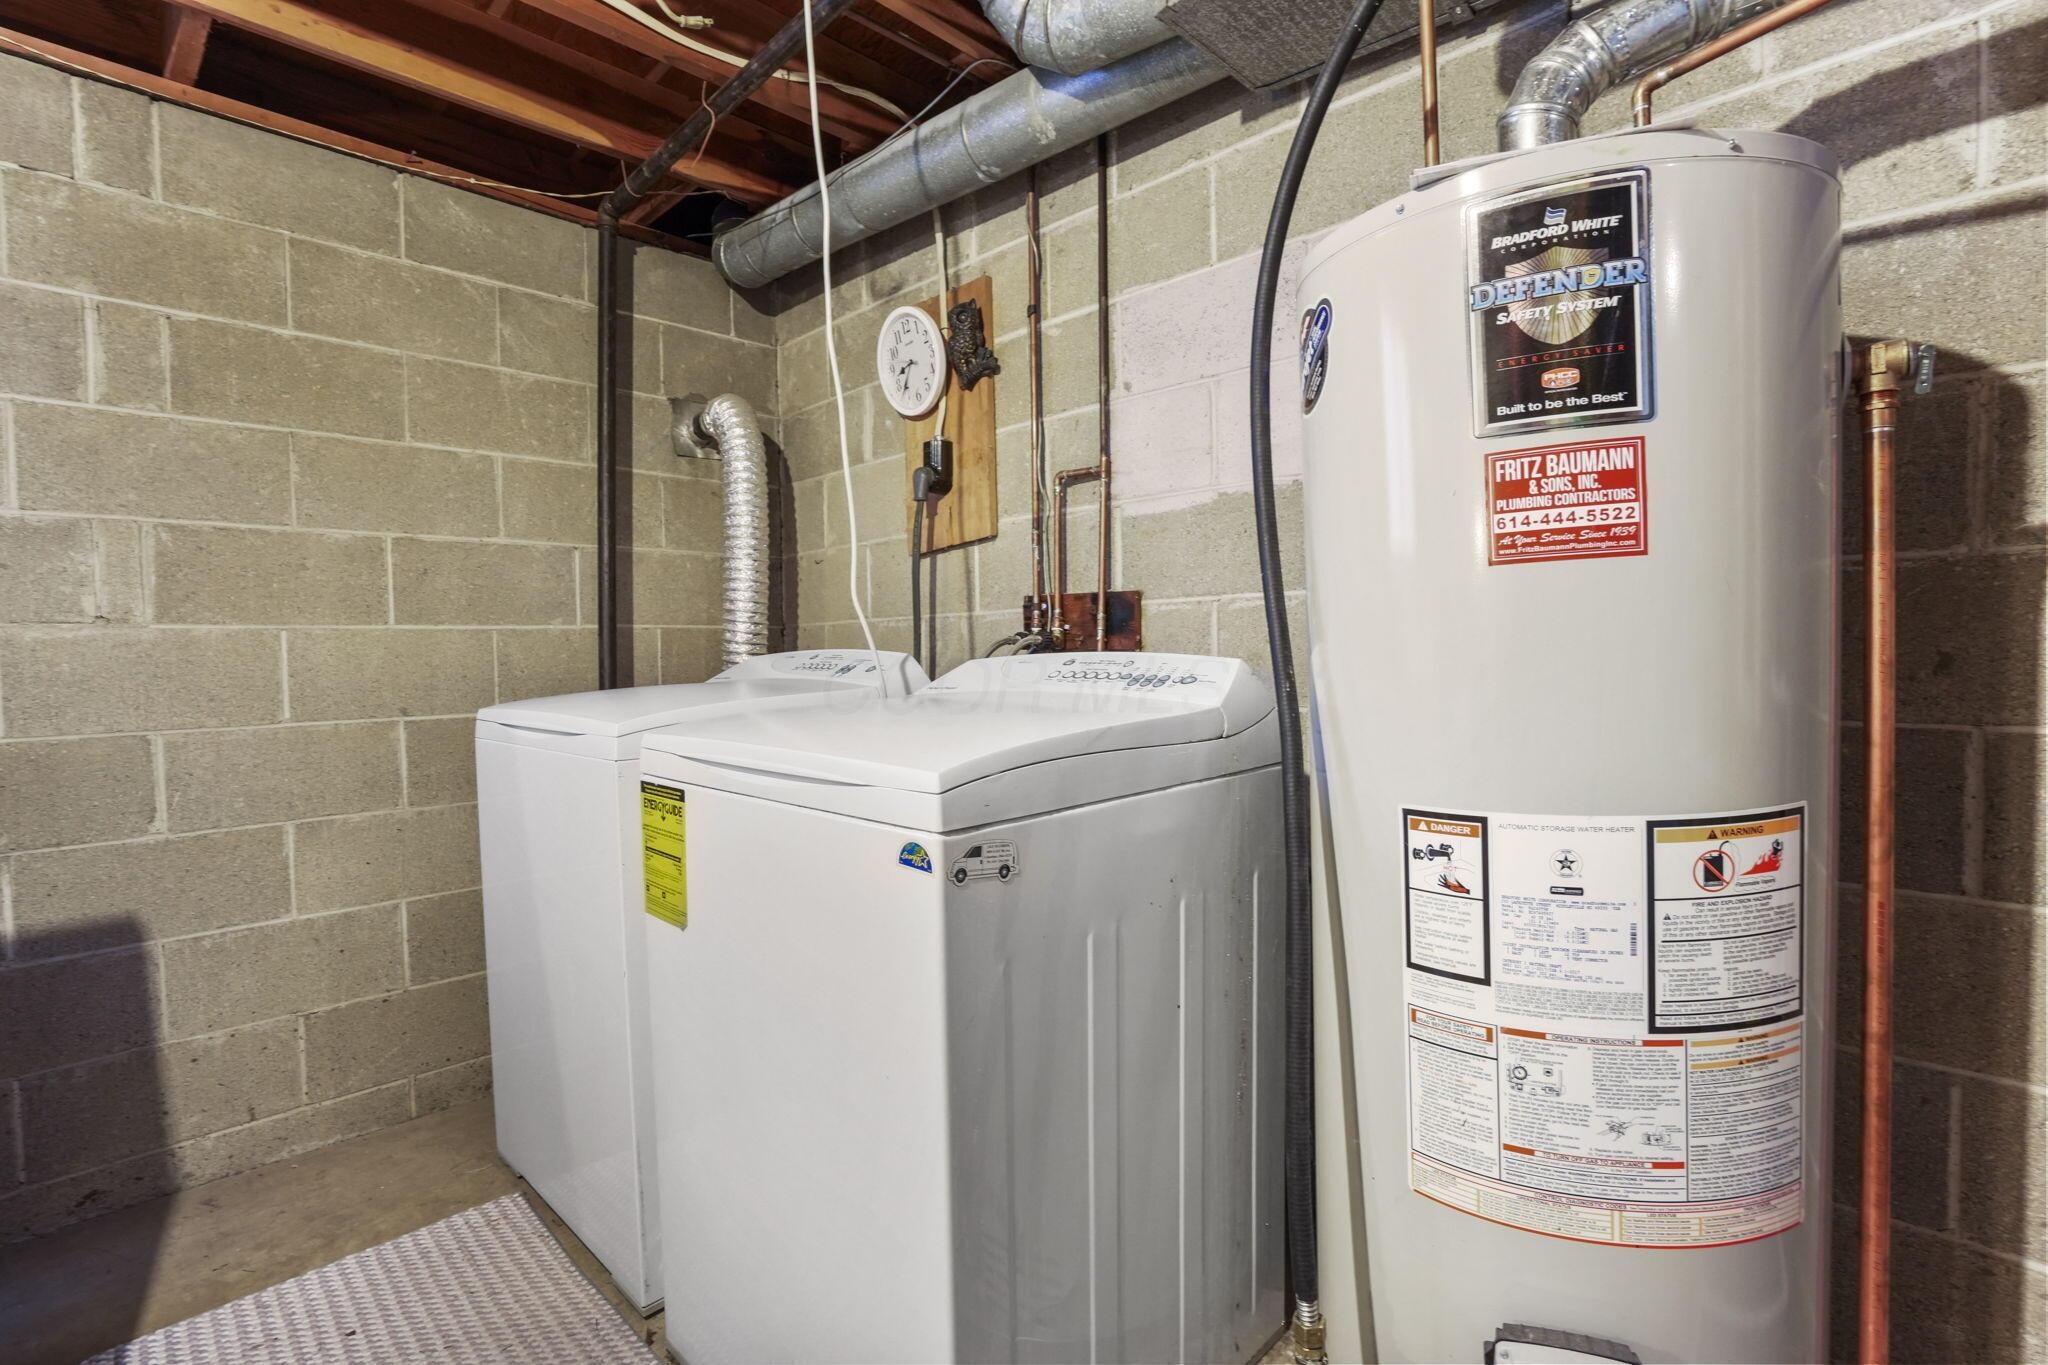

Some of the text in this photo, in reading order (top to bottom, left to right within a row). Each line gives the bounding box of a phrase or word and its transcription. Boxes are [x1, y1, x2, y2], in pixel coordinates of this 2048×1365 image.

[1491, 215, 1623, 250] BRADFORD WHITE
[1500, 229, 1610, 254] CORPORATION
[1471, 257, 1647, 311] DEFENDER
[1496, 295, 1622, 325] SAFETY SYSTEM
[901, 319, 911, 334] 12
[1497, 344, 1625, 369] ENERGY SAVER
[1497, 392, 1624, 416] Built to be the Best
[1495, 447, 1634, 482] FRITZ BAUMANN
[1529, 474, 1602, 494] & SONS, INC.
[1496, 488, 1636, 512] PLUMBING CONTRACTORS
[1497, 506, 1636, 530] 614-444-5522
[1498, 536, 1513, 546] At
[1513, 534, 1537, 546] Your
[1540, 532, 1575, 543] Service
[1579, 529, 1606, 539] Since
[1430, 823, 1471, 835] DANGER
[1498, 823, 1539, 832] AUTOMATIC
[1720, 825, 1764, 837] WARNING
[1431, 1020, 1452, 1030] BEFORE
[1454, 1026, 1485, 1039] OPERATING
[1437, 1016, 1452, 1025] YOUR
[1453, 1021, 1473, 1030] SAFETY
[1551, 1034, 1636, 1046] OPERATING INSTRUCTIONS
[1553, 1153, 1570, 1161] TURN
[1610, 1160, 1646, 1168] APPLIANCE
